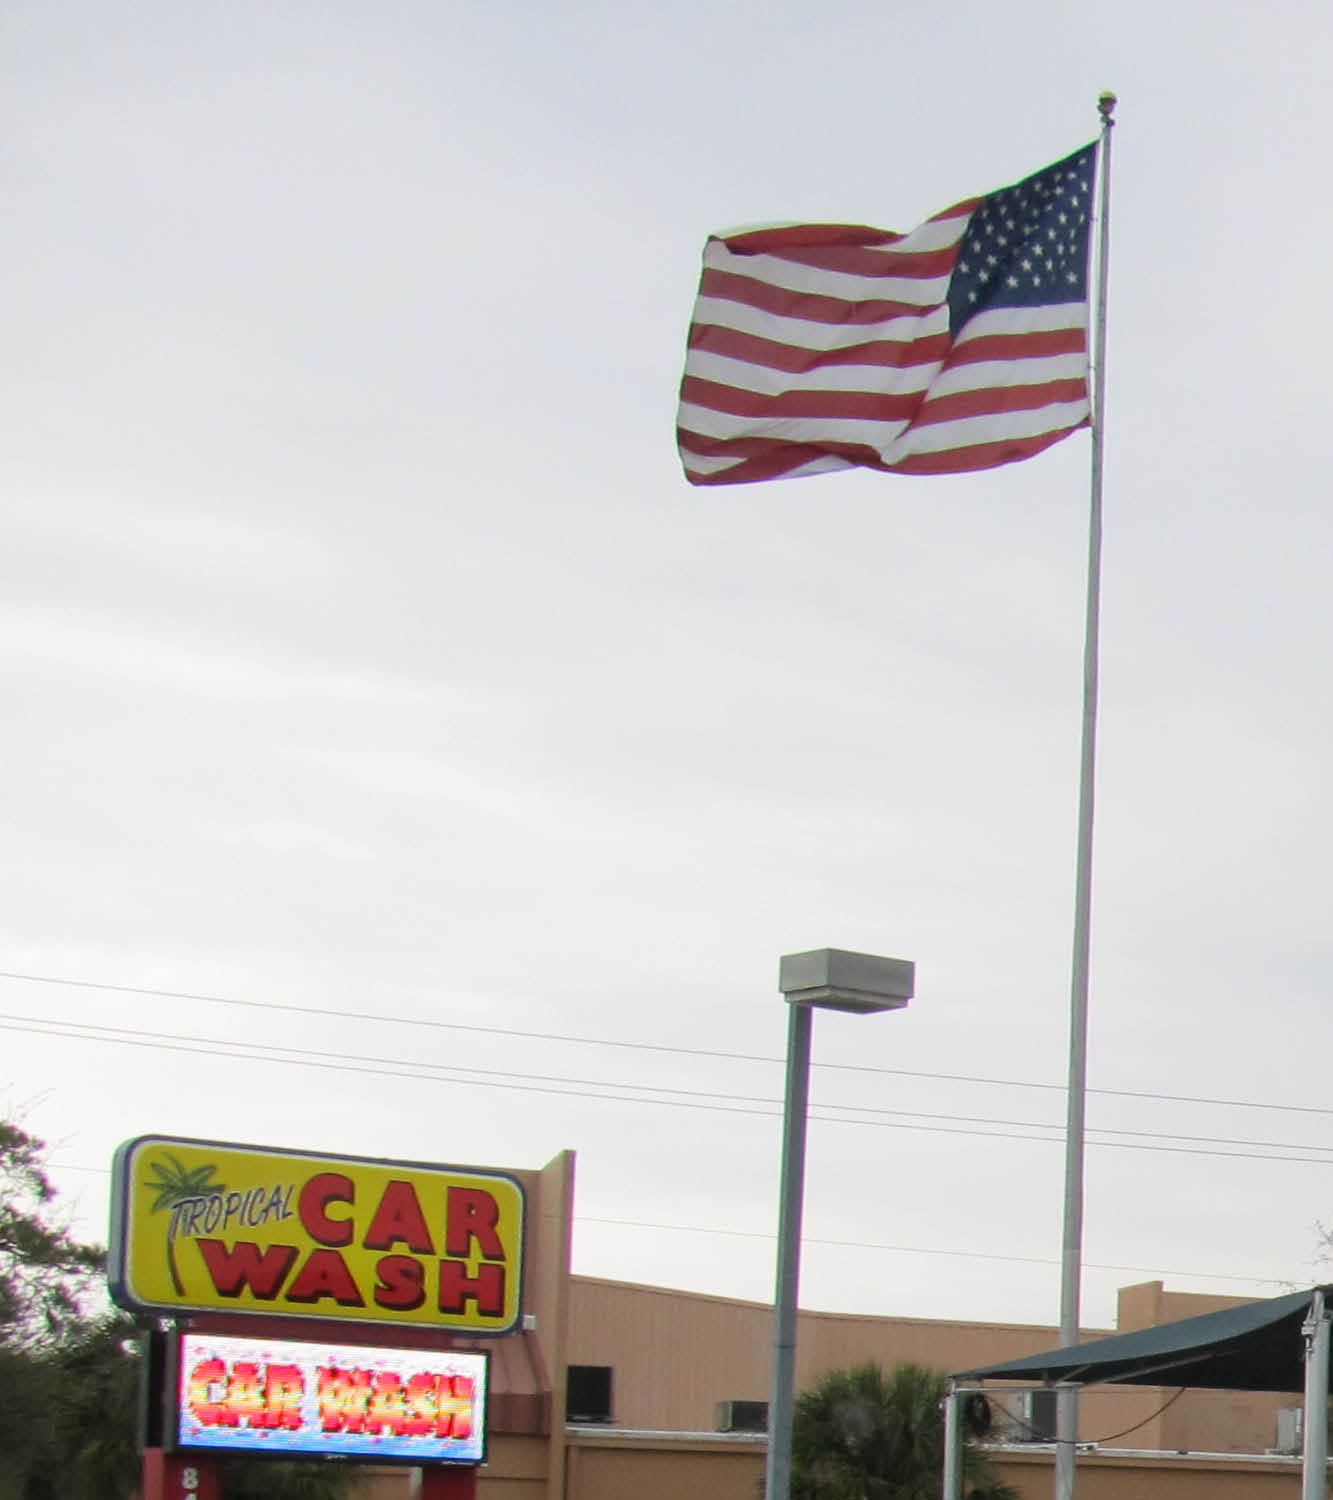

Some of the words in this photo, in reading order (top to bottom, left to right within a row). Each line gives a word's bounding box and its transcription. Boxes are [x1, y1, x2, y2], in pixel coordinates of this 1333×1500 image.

[168, 1184, 294, 1240] TROPICAL
[299, 1172, 506, 1262] CAR
[196, 1238, 506, 1318] WASH
[189, 1357, 305, 1430] CAR
[317, 1364, 474, 1439] WASH
